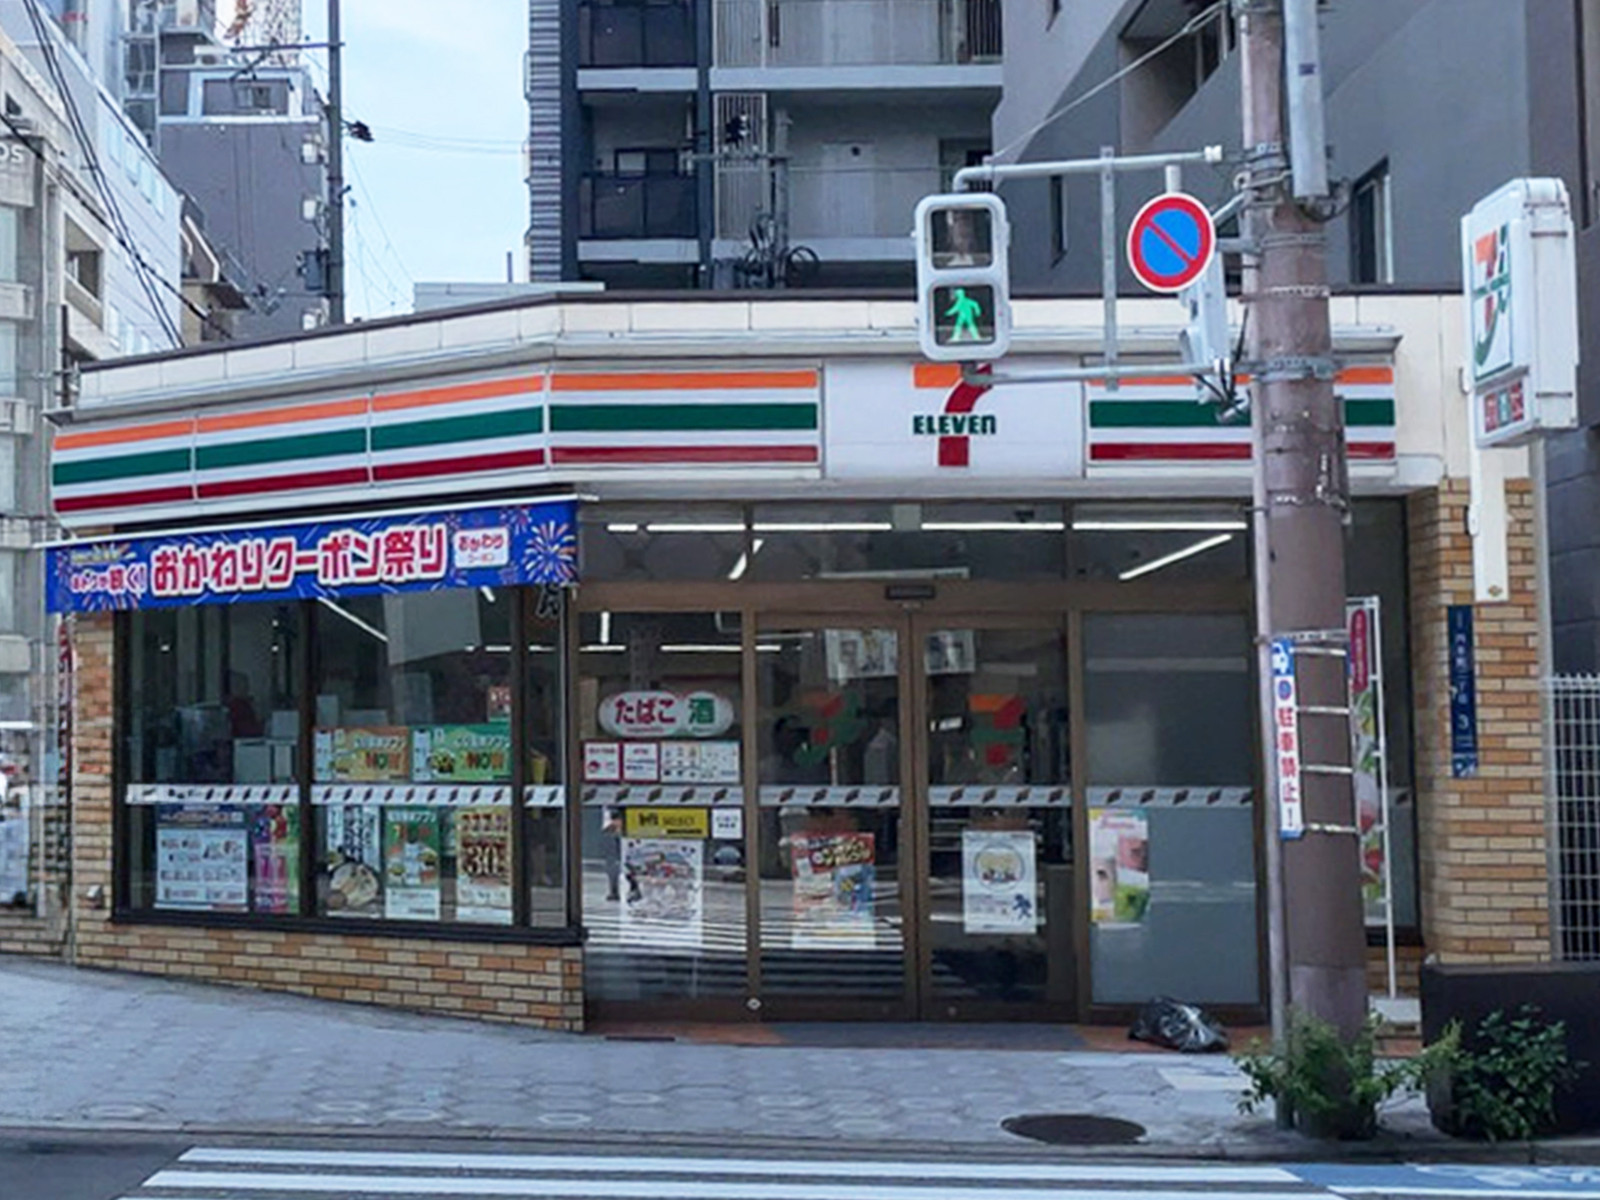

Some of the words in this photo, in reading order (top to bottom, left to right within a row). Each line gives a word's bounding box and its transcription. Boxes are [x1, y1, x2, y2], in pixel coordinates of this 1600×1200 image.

[151, 525, 447, 594] おかわりクーポン祭り
[614, 698, 677, 725] たばこ
[687, 697, 716, 724] 酒
